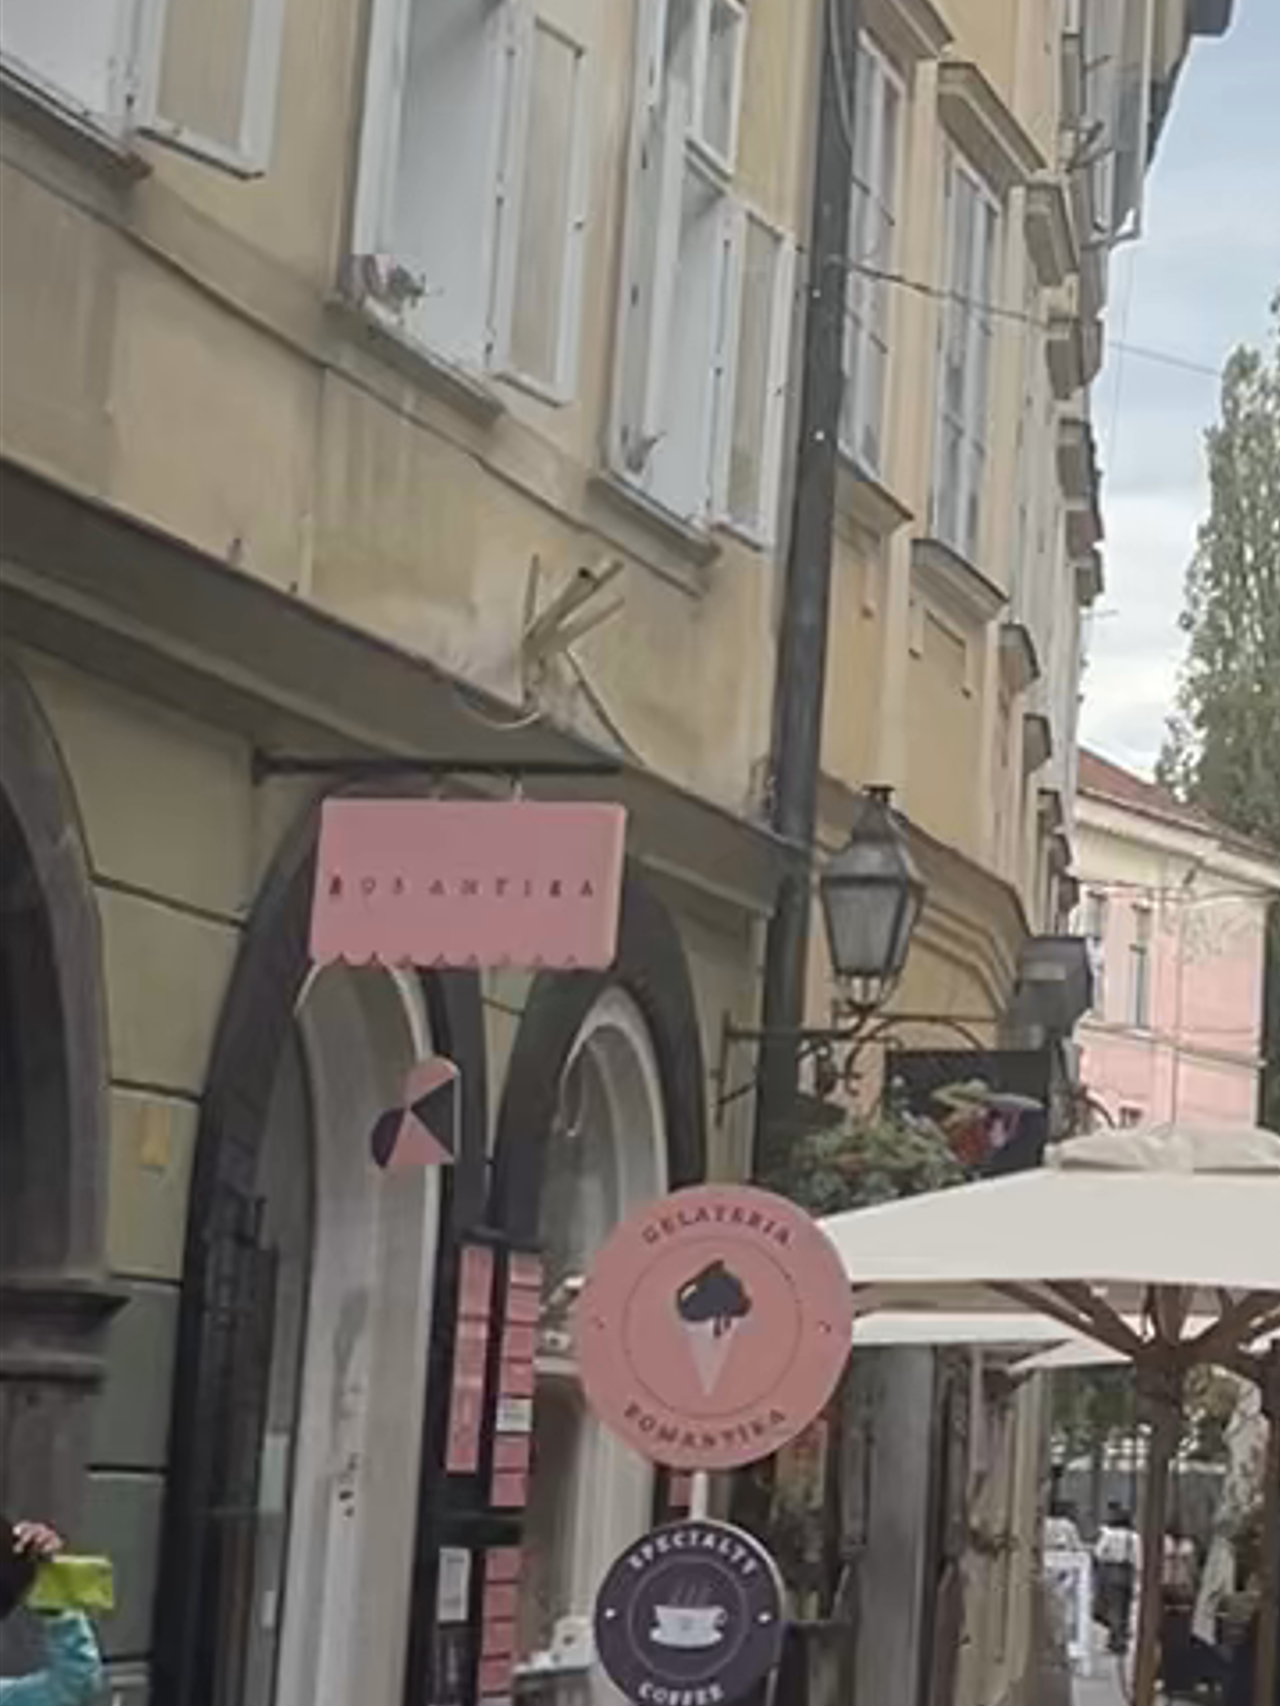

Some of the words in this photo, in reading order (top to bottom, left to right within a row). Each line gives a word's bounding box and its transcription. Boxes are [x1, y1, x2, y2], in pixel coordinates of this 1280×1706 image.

[641, 1206, 791, 1245] GELATERIA
[624, 1402, 786, 1447] ROMANTIKA
[628, 1530, 757, 1574] SPECIALTY
[638, 1682, 725, 1706] COFFEE
